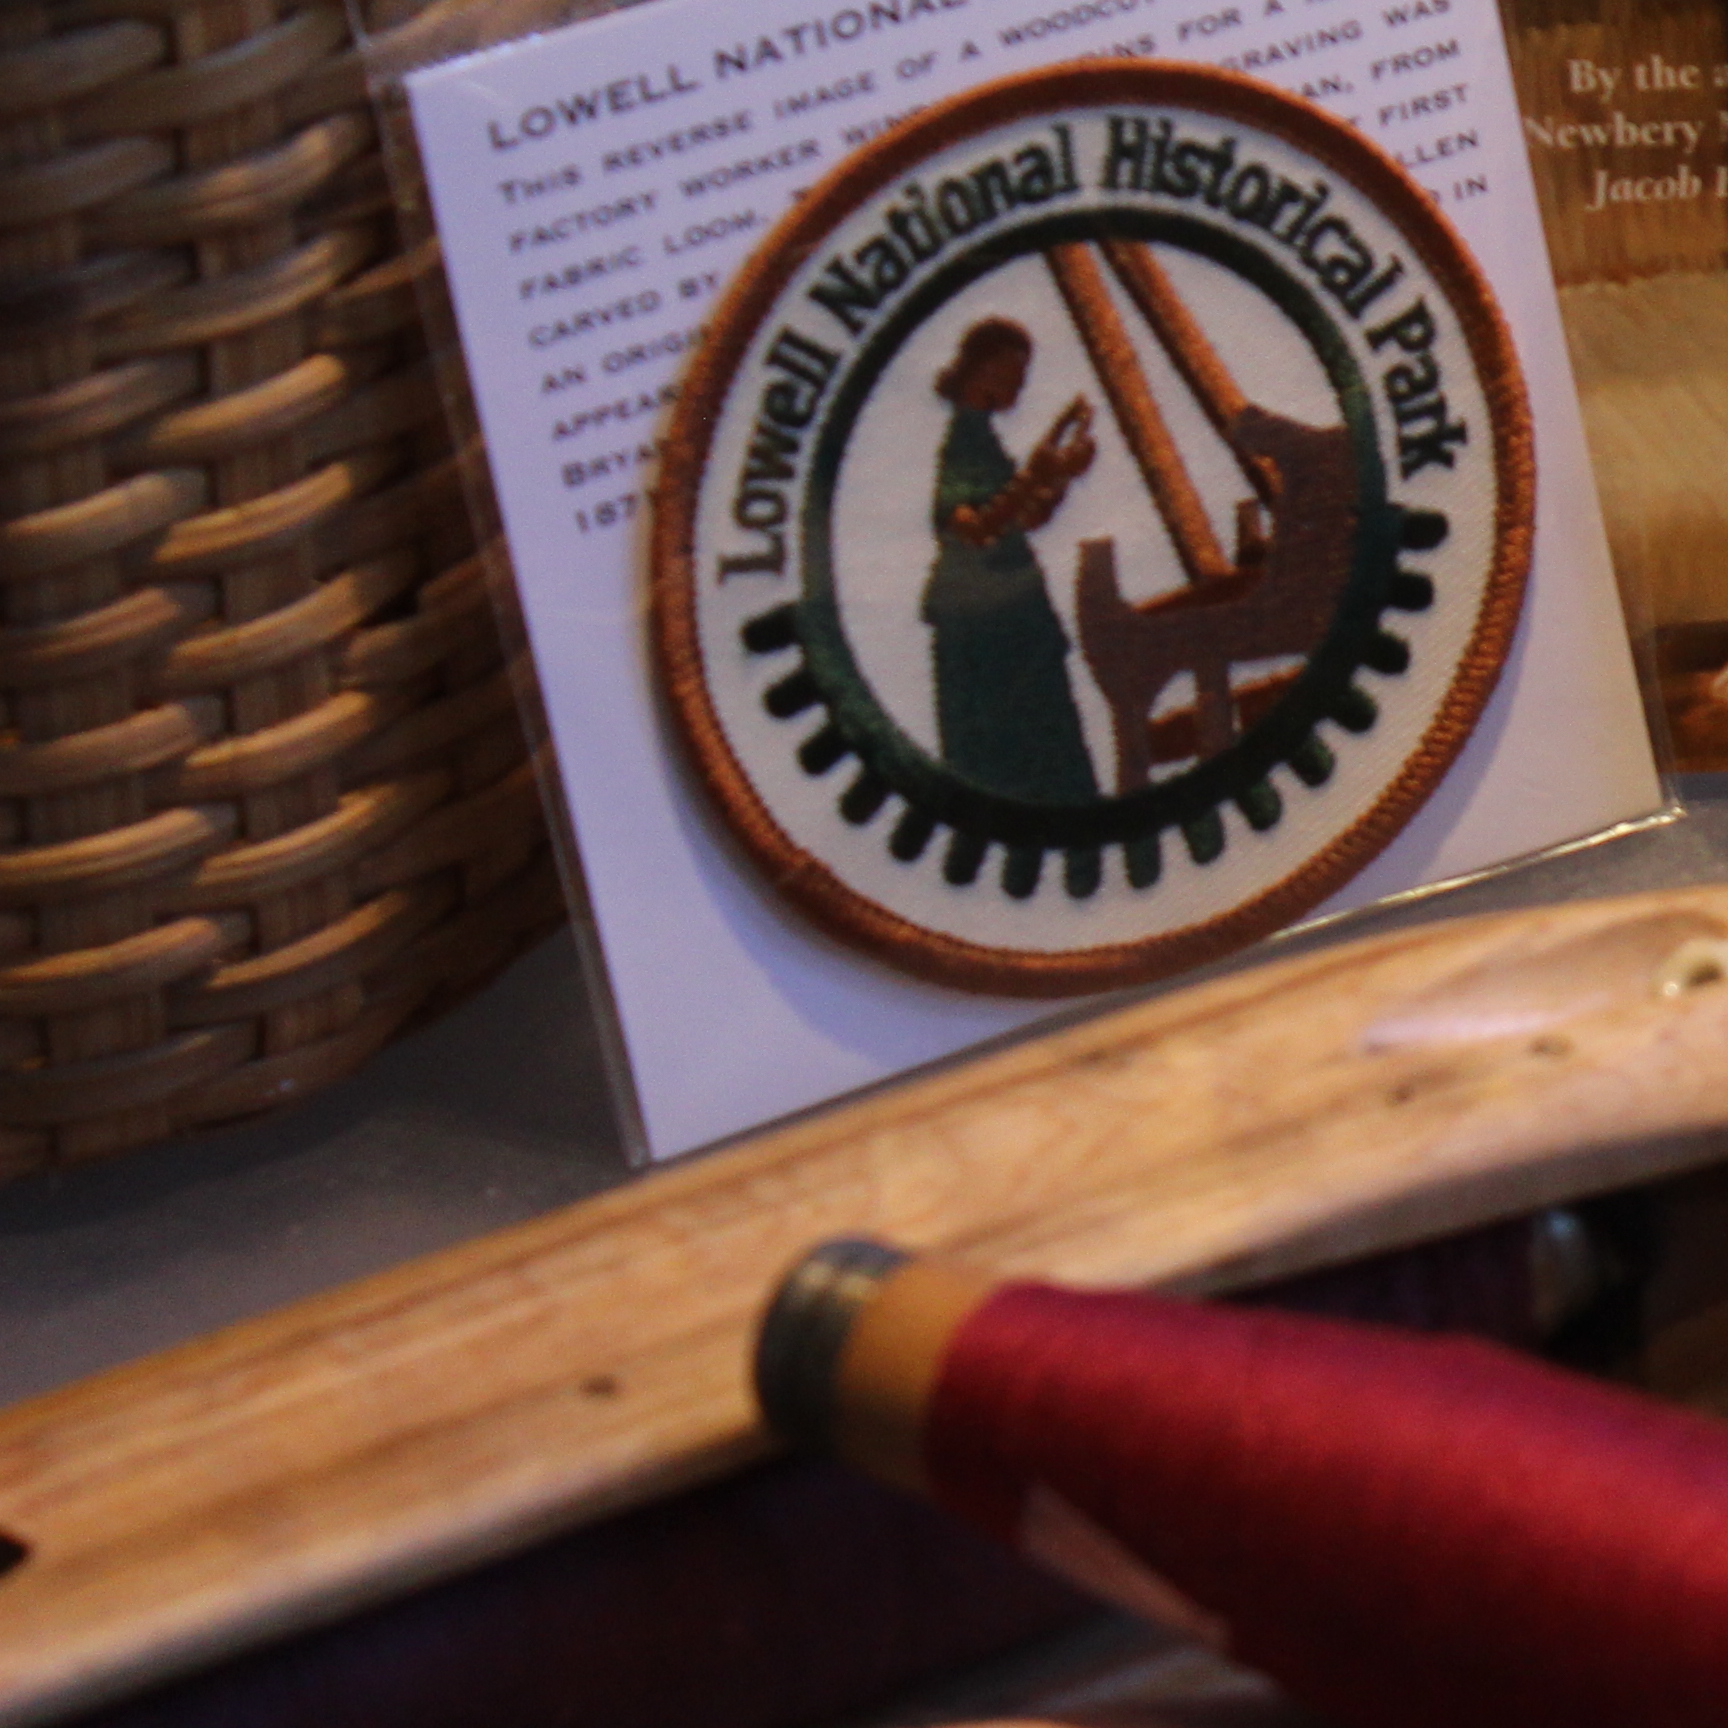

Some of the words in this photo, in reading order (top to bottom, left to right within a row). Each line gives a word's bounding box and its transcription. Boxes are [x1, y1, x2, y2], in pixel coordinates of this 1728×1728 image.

[489, 64, 699, 150] LOWELL
[1379, 83, 1468, 127] FIRST
[1567, 58, 1622, 103] By
[1634, 54, 1701, 91] the
[509, 187, 660, 253] FACTORY
[681, 137, 822, 197] WORKER
[1178, 8, 1243, 42] FOR
[605, 109, 751, 173] REVERSE
[775, 71, 876, 122] IMAGE
[899, 51, 939, 83] OF
[1522, 111, 1702, 154] Newbery
[528, 290, 662, 351] CARVED
[1370, 38, 1461, 80] FROM
[1453, 176, 1488, 201] IN
[1584, 164, 1702, 212] Jacob
[518, 244, 643, 301] FABRIC
[716, 327, 842, 587] Lowell
[808, 122, 1083, 338] National
[1103, 112, 1402, 317] Historical
[1366, 296, 1470, 482] Park
